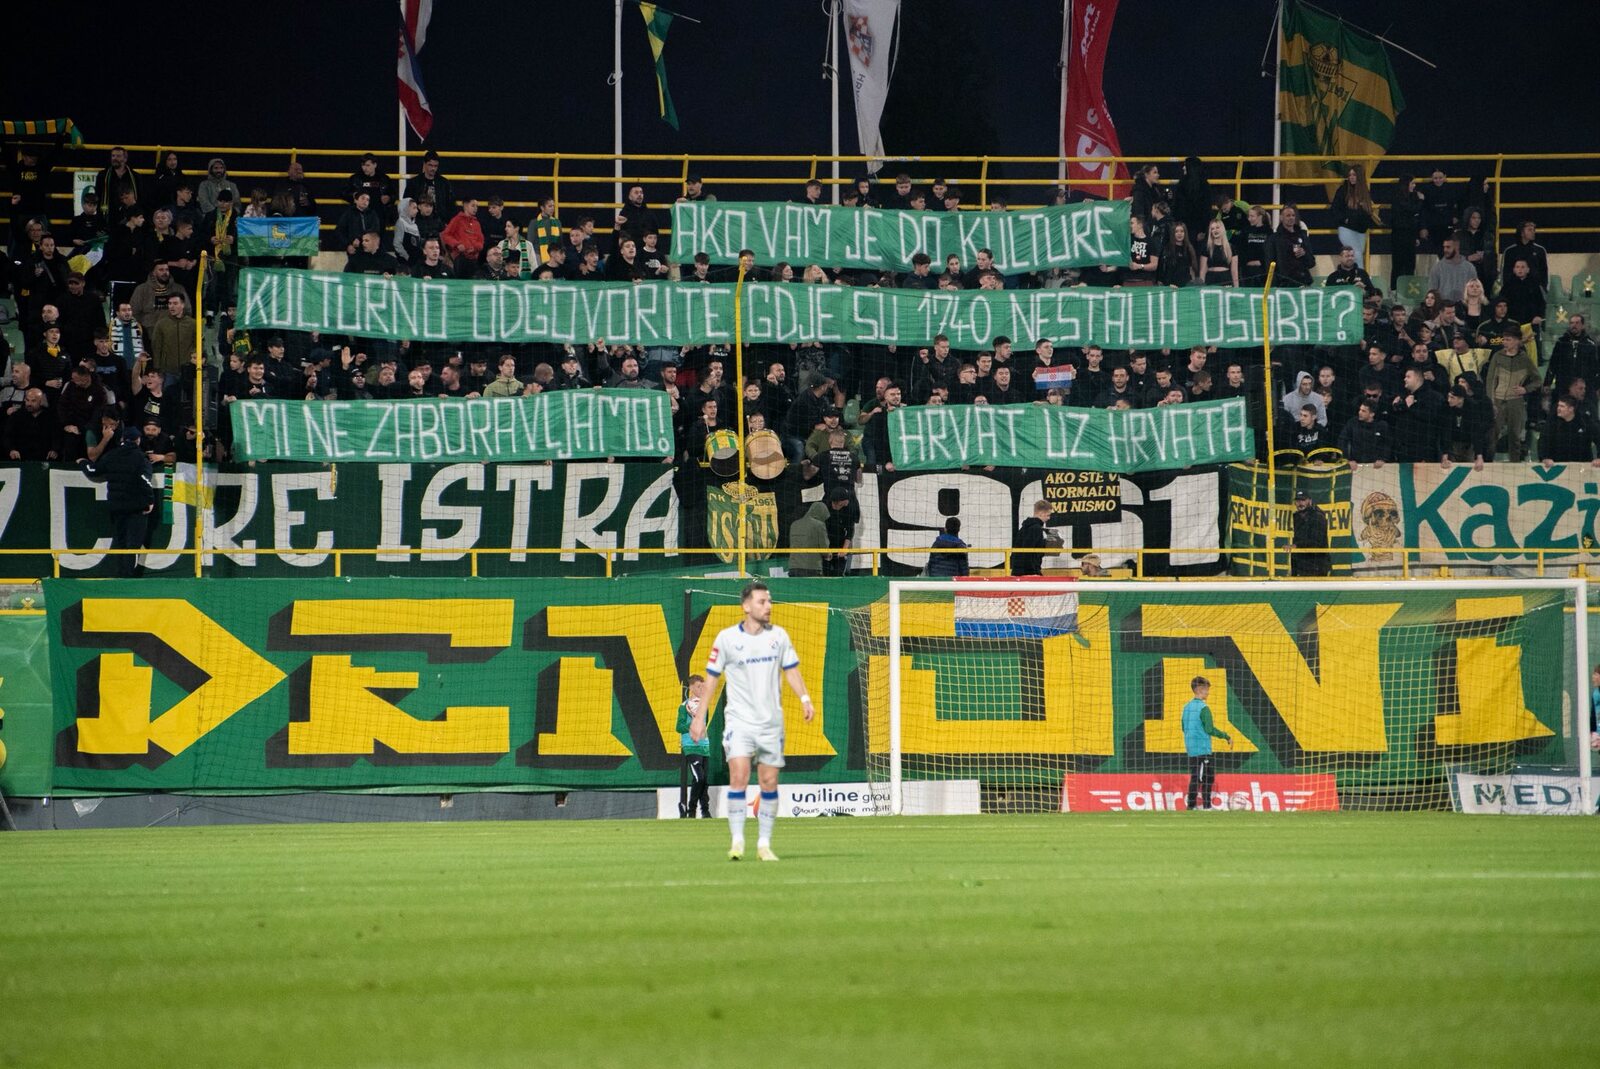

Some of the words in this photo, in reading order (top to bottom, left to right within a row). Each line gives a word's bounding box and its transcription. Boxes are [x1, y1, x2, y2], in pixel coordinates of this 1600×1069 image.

[676, 202, 748, 257] AKO
[758, 201, 831, 259] VAM
[846, 210, 882, 262] JE
[900, 211, 941, 269] DO
[960, 206, 1122, 269] KULTURE
[244, 272, 448, 340] KULTURNO
[473, 283, 731, 341] ODGOVORITE
[749, 285, 841, 341] GDJE
[855, 289, 898, 342] SU
[917, 288, 991, 345] 1740
[1011, 291, 1179, 346] NESTALIH
[1201, 288, 1357, 345] OSOBA?
[241, 400, 290, 456] MI
[303, 403, 354, 456] NE
[364, 390, 670, 459] ZABORAVLJAMO!
[899, 407, 1025, 464] HRVAT
[1043, 408, 1095, 458] UZ
[1108, 401, 1246, 464] HRVATA
[1045, 471, 1075, 484] AKO
[1079, 471, 1104, 483] STE
[1046, 485, 1120, 498] NORMALNI
[375, 462, 680, 563] ISTRA
[754, 498, 775, 507] 1961
[1050, 501, 1067, 513] MI
[1070, 499, 1116, 512] NISMO
[1231, 501, 1270, 528] SEVEN
[76, 596, 1556, 757] DEMONI
[792, 788, 859, 802] uniline
[862, 793, 890, 804] grou
[1127, 782, 1280, 811] airash
